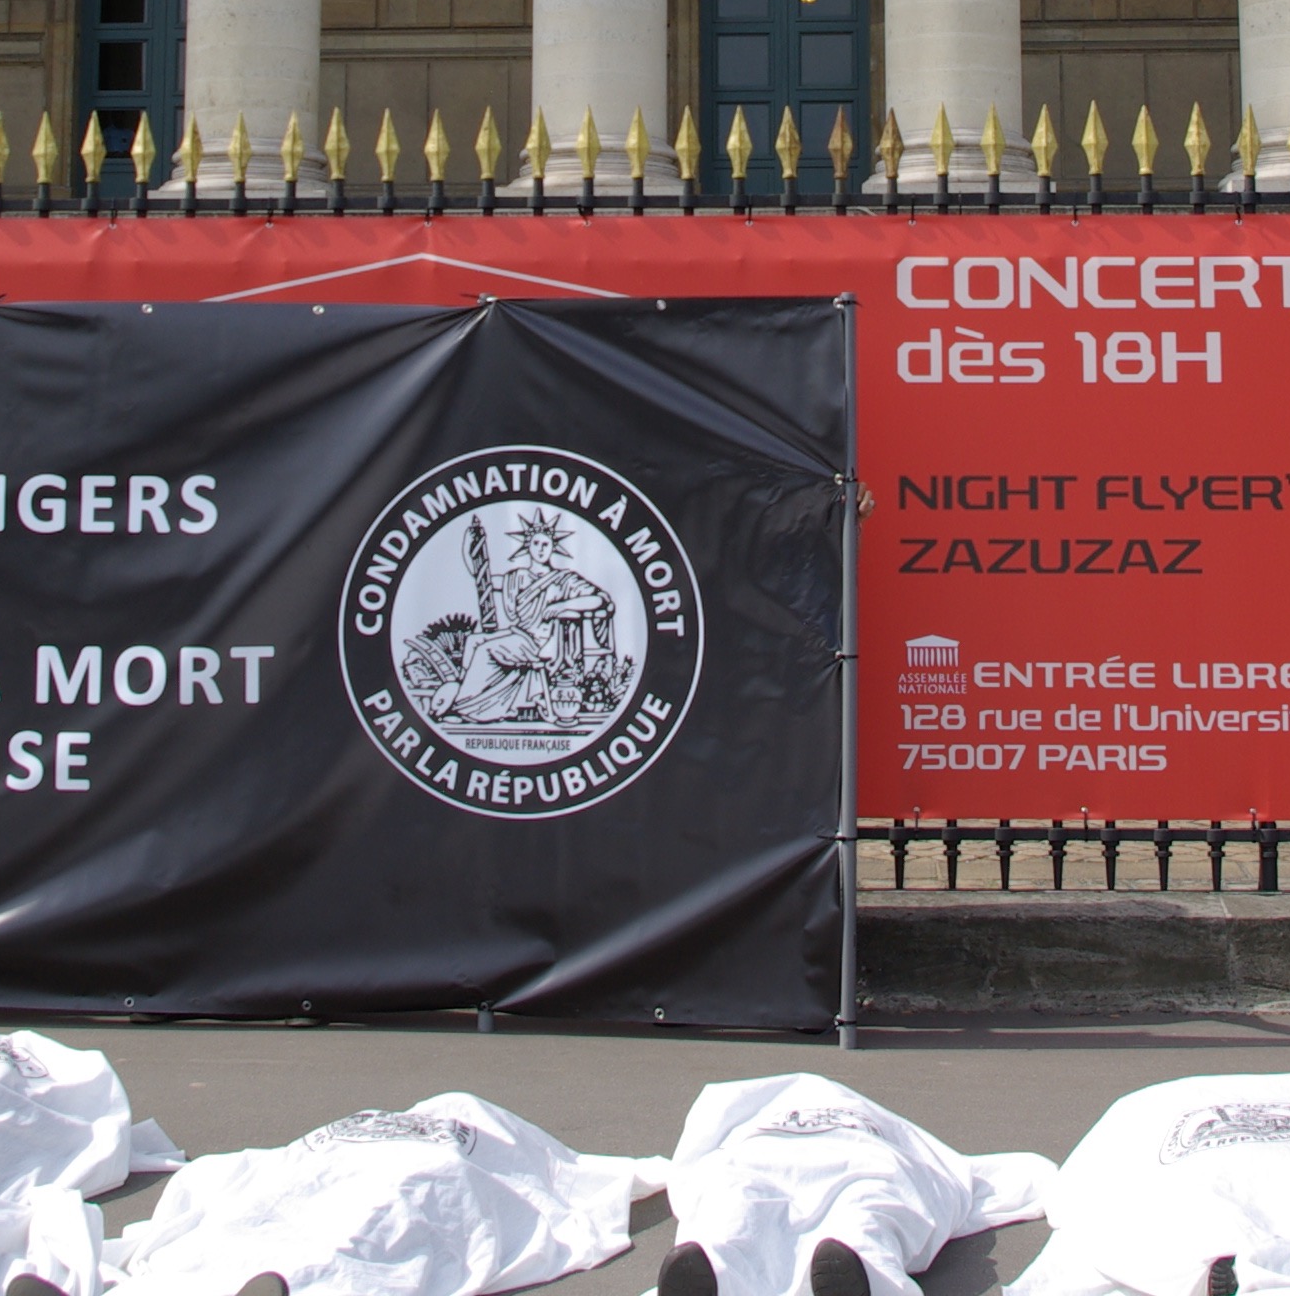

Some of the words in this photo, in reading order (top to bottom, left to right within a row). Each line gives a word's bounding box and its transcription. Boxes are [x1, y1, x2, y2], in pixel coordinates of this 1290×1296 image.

[897, 326, 1045, 383] dès
[1075, 331, 1222, 383] 18H
[898, 476, 1077, 510] NIGHT
[355, 463, 599, 636] CONDAMNATION
[598, 495, 629, 531] À
[624, 527, 685, 637] MORT
[898, 539, 1203, 574] ZAZUZAZ
[36, 645, 275, 705] MORT
[898, 671, 967, 683] ASSEMBLÉE
[898, 684, 967, 694] NATIONALE
[974, 655, 1156, 689] ENTRÉE
[901, 704, 966, 730] 128
[979, 709, 1042, 731] rue
[1054, 703, 1101, 731] de
[363, 688, 423, 759] PAR
[415, 748, 458, 789] LA
[466, 693, 672, 804] RÉPUBLIQUE
[522, 740, 571, 753] FRANÇAISE
[898, 744, 1026, 770] 75007
[1038, 744, 1167, 771] PARIS
